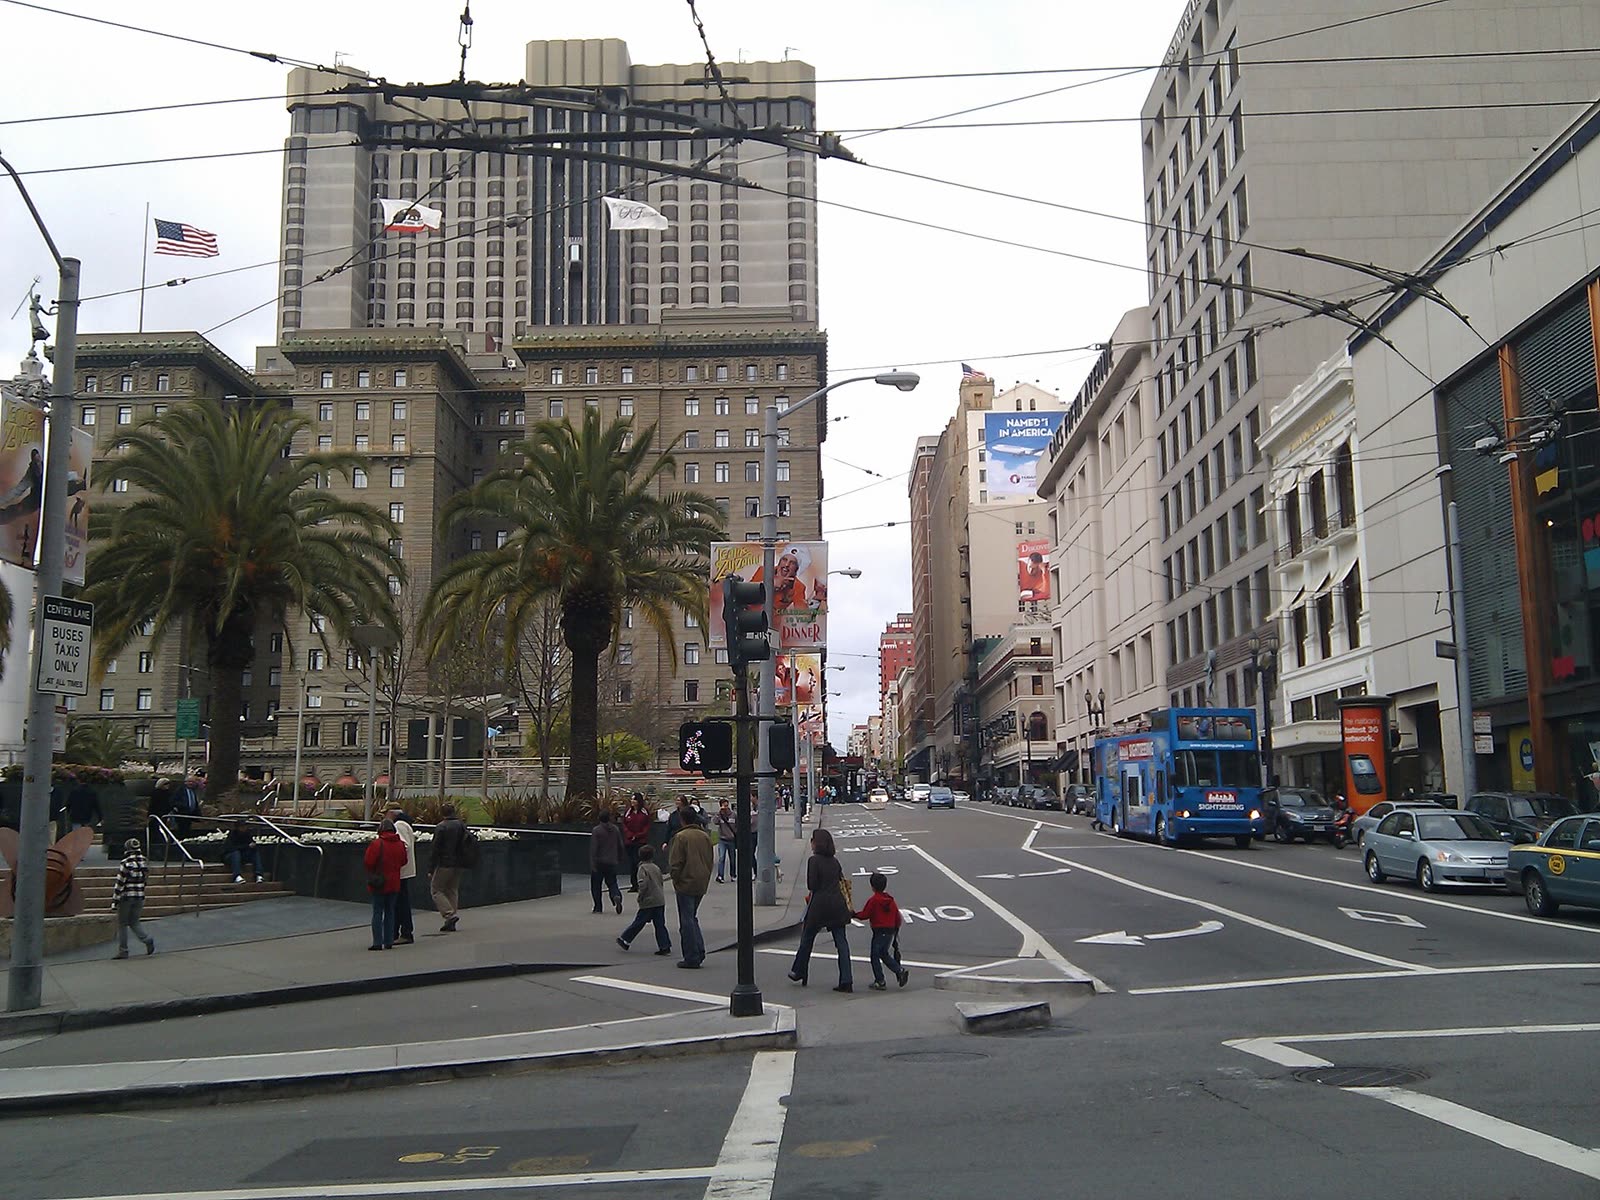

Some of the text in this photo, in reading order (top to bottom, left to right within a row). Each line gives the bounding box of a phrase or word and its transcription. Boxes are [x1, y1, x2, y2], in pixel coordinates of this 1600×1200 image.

[1006, 418, 1040, 427] NAMED
[999, 428, 1053, 438] IN AMERICA
[46, 603, 91, 620] CENTER LANE
[52, 626, 84, 643] BUSES
[782, 624, 821, 642] DINNER
[54, 642, 80, 658] TAXIS
[54, 658, 78, 673] ONLY
[45, 677, 83, 689] AT ALL TIMES
[1198, 803, 1244, 811] SIGHTSEEING
